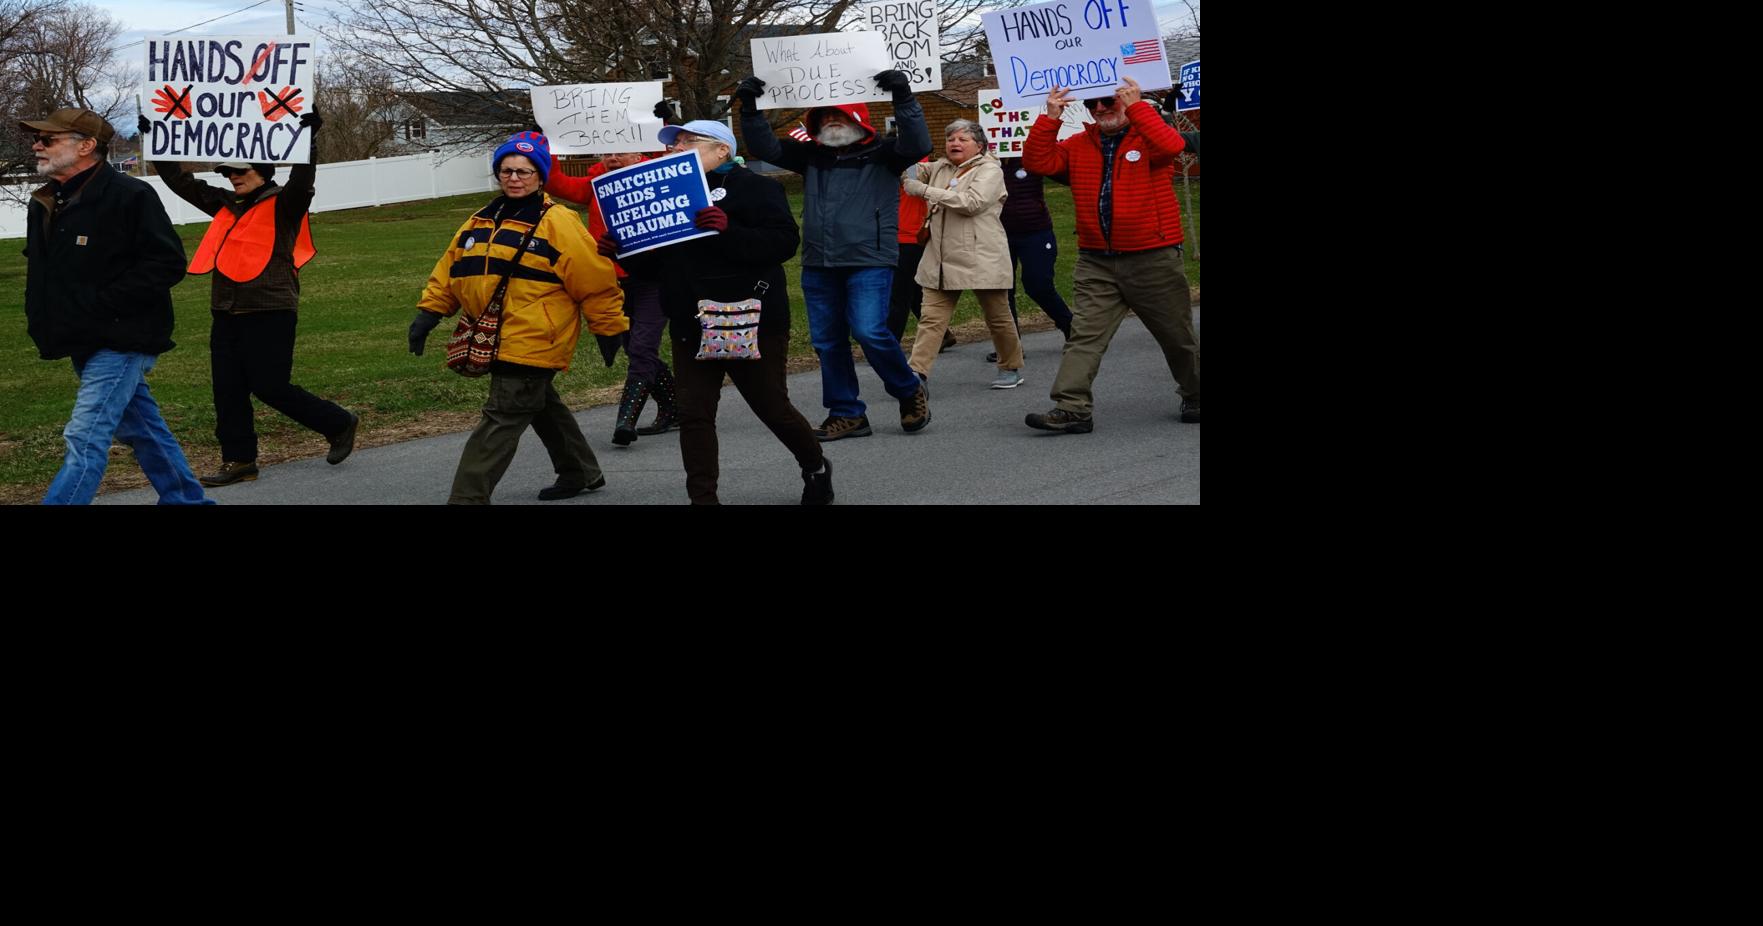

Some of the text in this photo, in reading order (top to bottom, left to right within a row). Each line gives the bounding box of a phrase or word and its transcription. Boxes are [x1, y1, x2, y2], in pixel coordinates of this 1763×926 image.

[870, 0, 934, 24] BRING
[1001, 0, 1129, 42] HANDS OFF
[874, 20, 932, 41] BACK
[149, 40, 310, 85] HANDS OFF
[779, 63, 840, 84] DUE
[894, 60, 917, 71] AND
[196, 91, 255, 118] our
[551, 87, 632, 110] BRING
[557, 108, 631, 124] THEM
[994, 111, 1029, 122] THE
[152, 120, 304, 161] DEMOCRACY
[988, 141, 1027, 152] FEE
[598, 161, 693, 199] SNATCHING
[615, 186, 656, 209] KIDS
[610, 194, 690, 226] LIFELONG
[617, 211, 690, 240] TRAUMA
